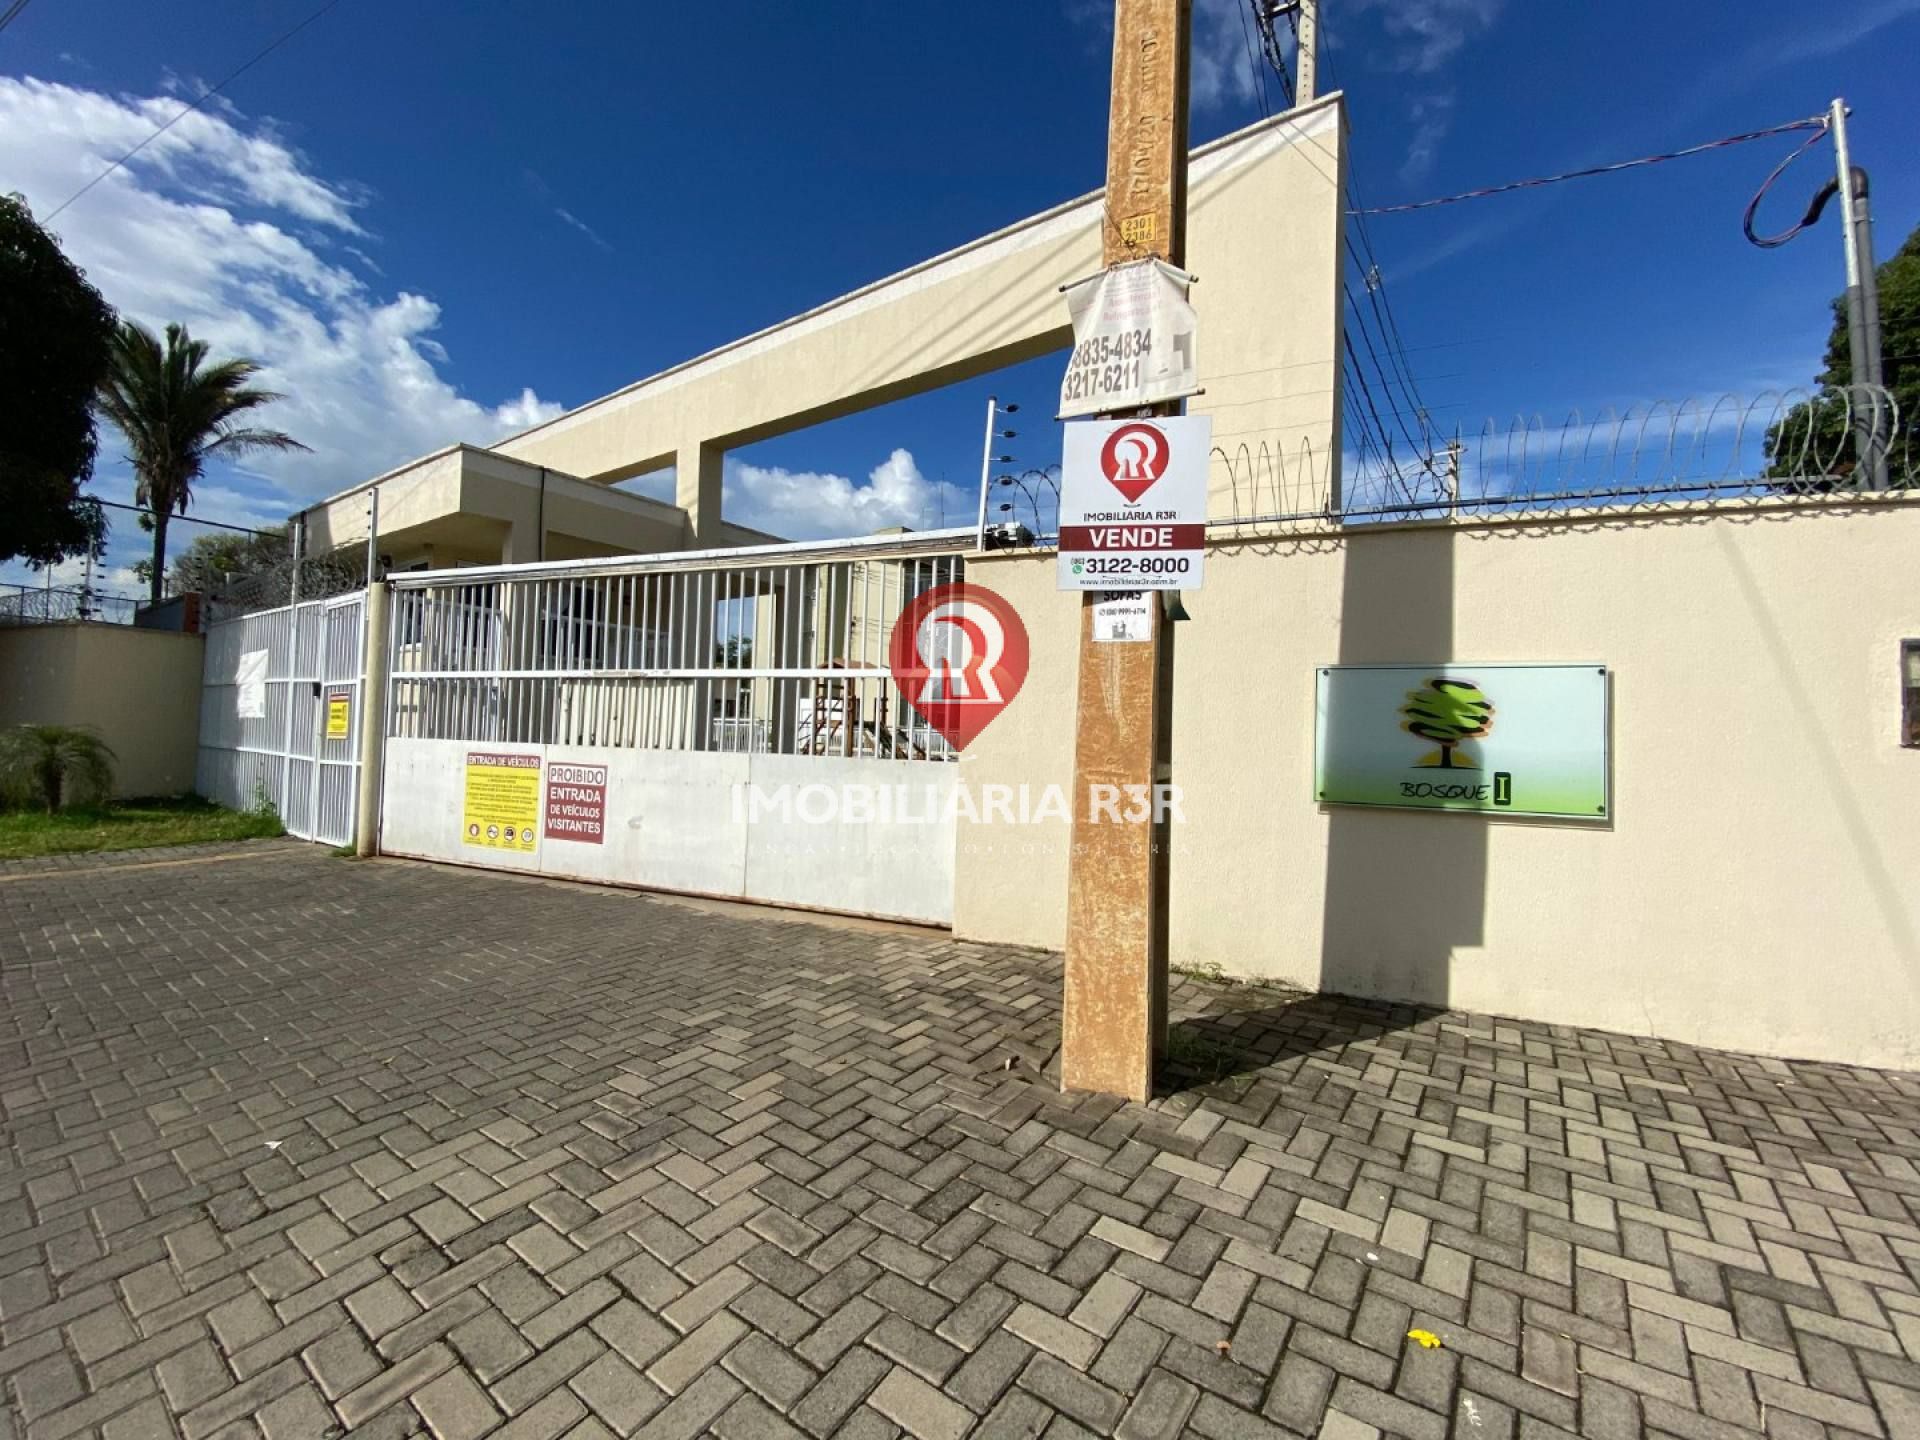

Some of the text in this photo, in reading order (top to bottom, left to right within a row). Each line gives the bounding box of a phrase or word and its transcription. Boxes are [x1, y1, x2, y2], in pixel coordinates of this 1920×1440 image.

[1065, 360, 1140, 401] 3217-6211
[1156, 511, 1176, 520] R3R
[1089, 527, 1173, 548] VENDE
[1086, 558, 1189, 573] 3122-8000
[468, 755, 496, 765] ENTRADA
[551, 767, 603, 784] PROIBIDO
[551, 786, 601, 803] ENTRADA
[1400, 782, 1491, 801] BOSQUE
[550, 803, 600, 818] DE VEÍCULOS
[548, 818, 601, 834] VISITANTES
